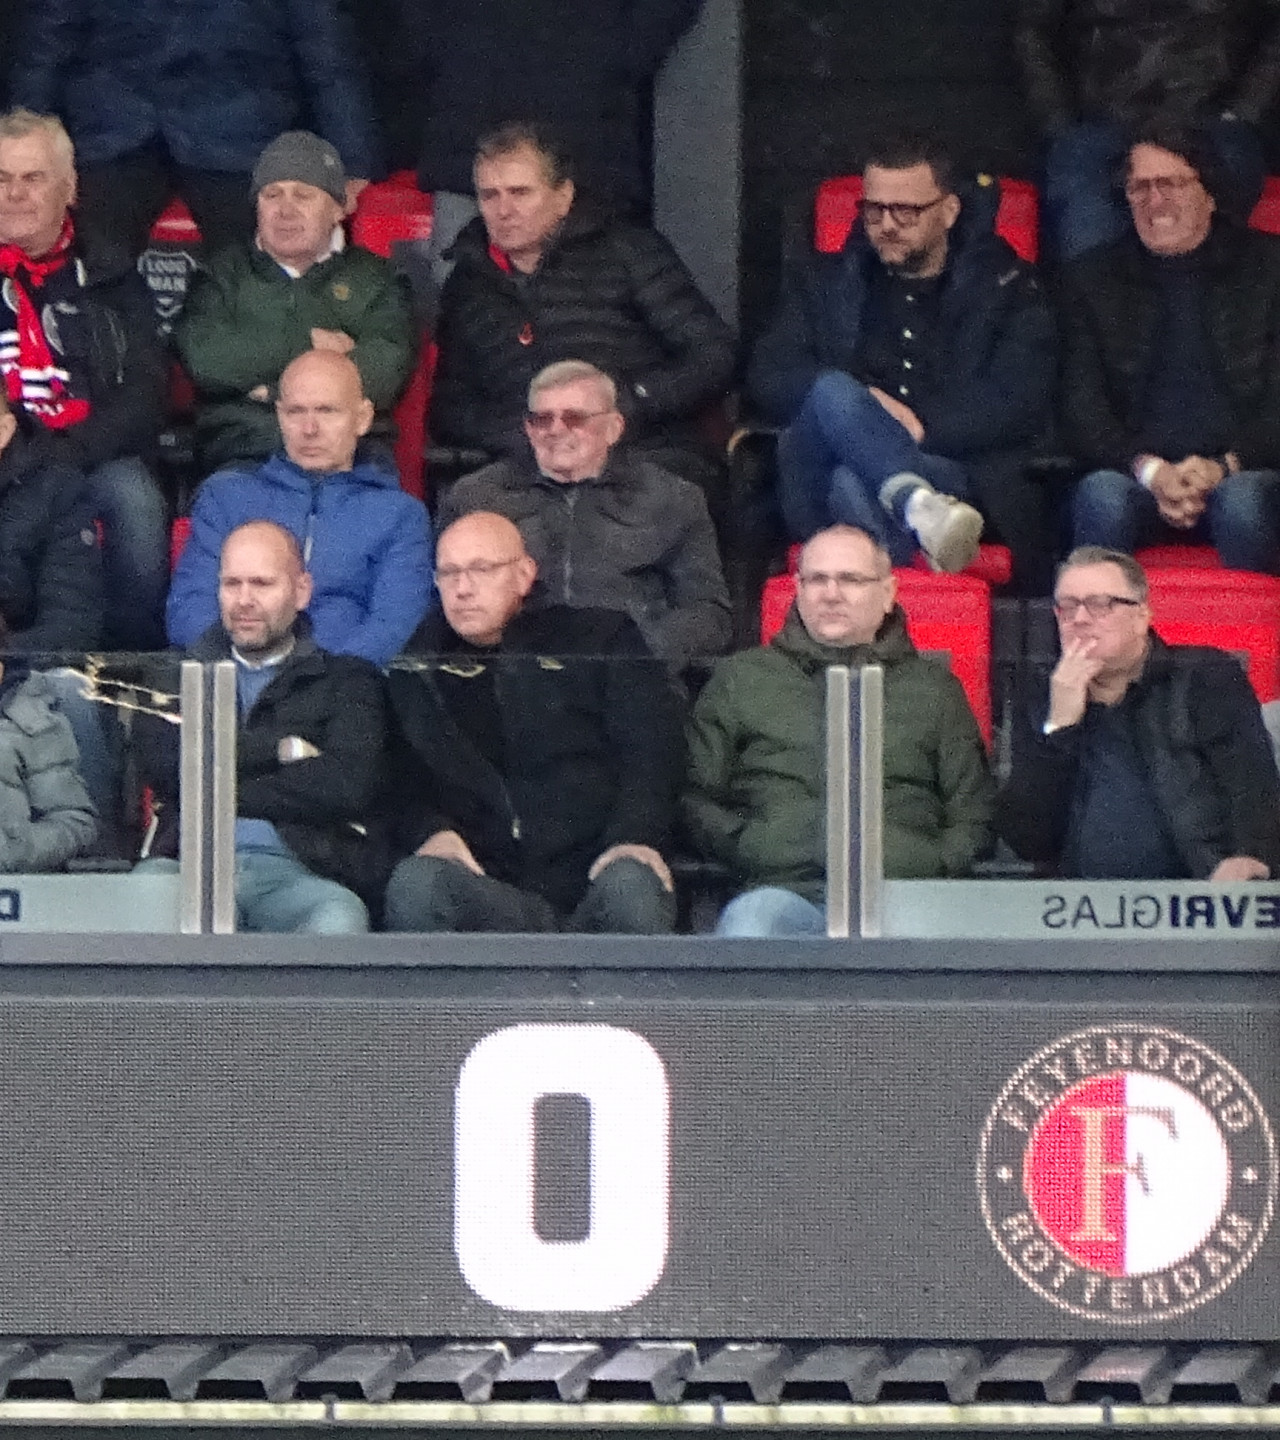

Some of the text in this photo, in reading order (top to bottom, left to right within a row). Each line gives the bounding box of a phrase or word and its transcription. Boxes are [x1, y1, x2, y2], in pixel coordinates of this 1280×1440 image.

[1001, 1036, 1253, 1132] FEYENOORD
[454, 1024, 669, 1313] 0
[1001, 1211, 1253, 1309] ROTTERDAM
